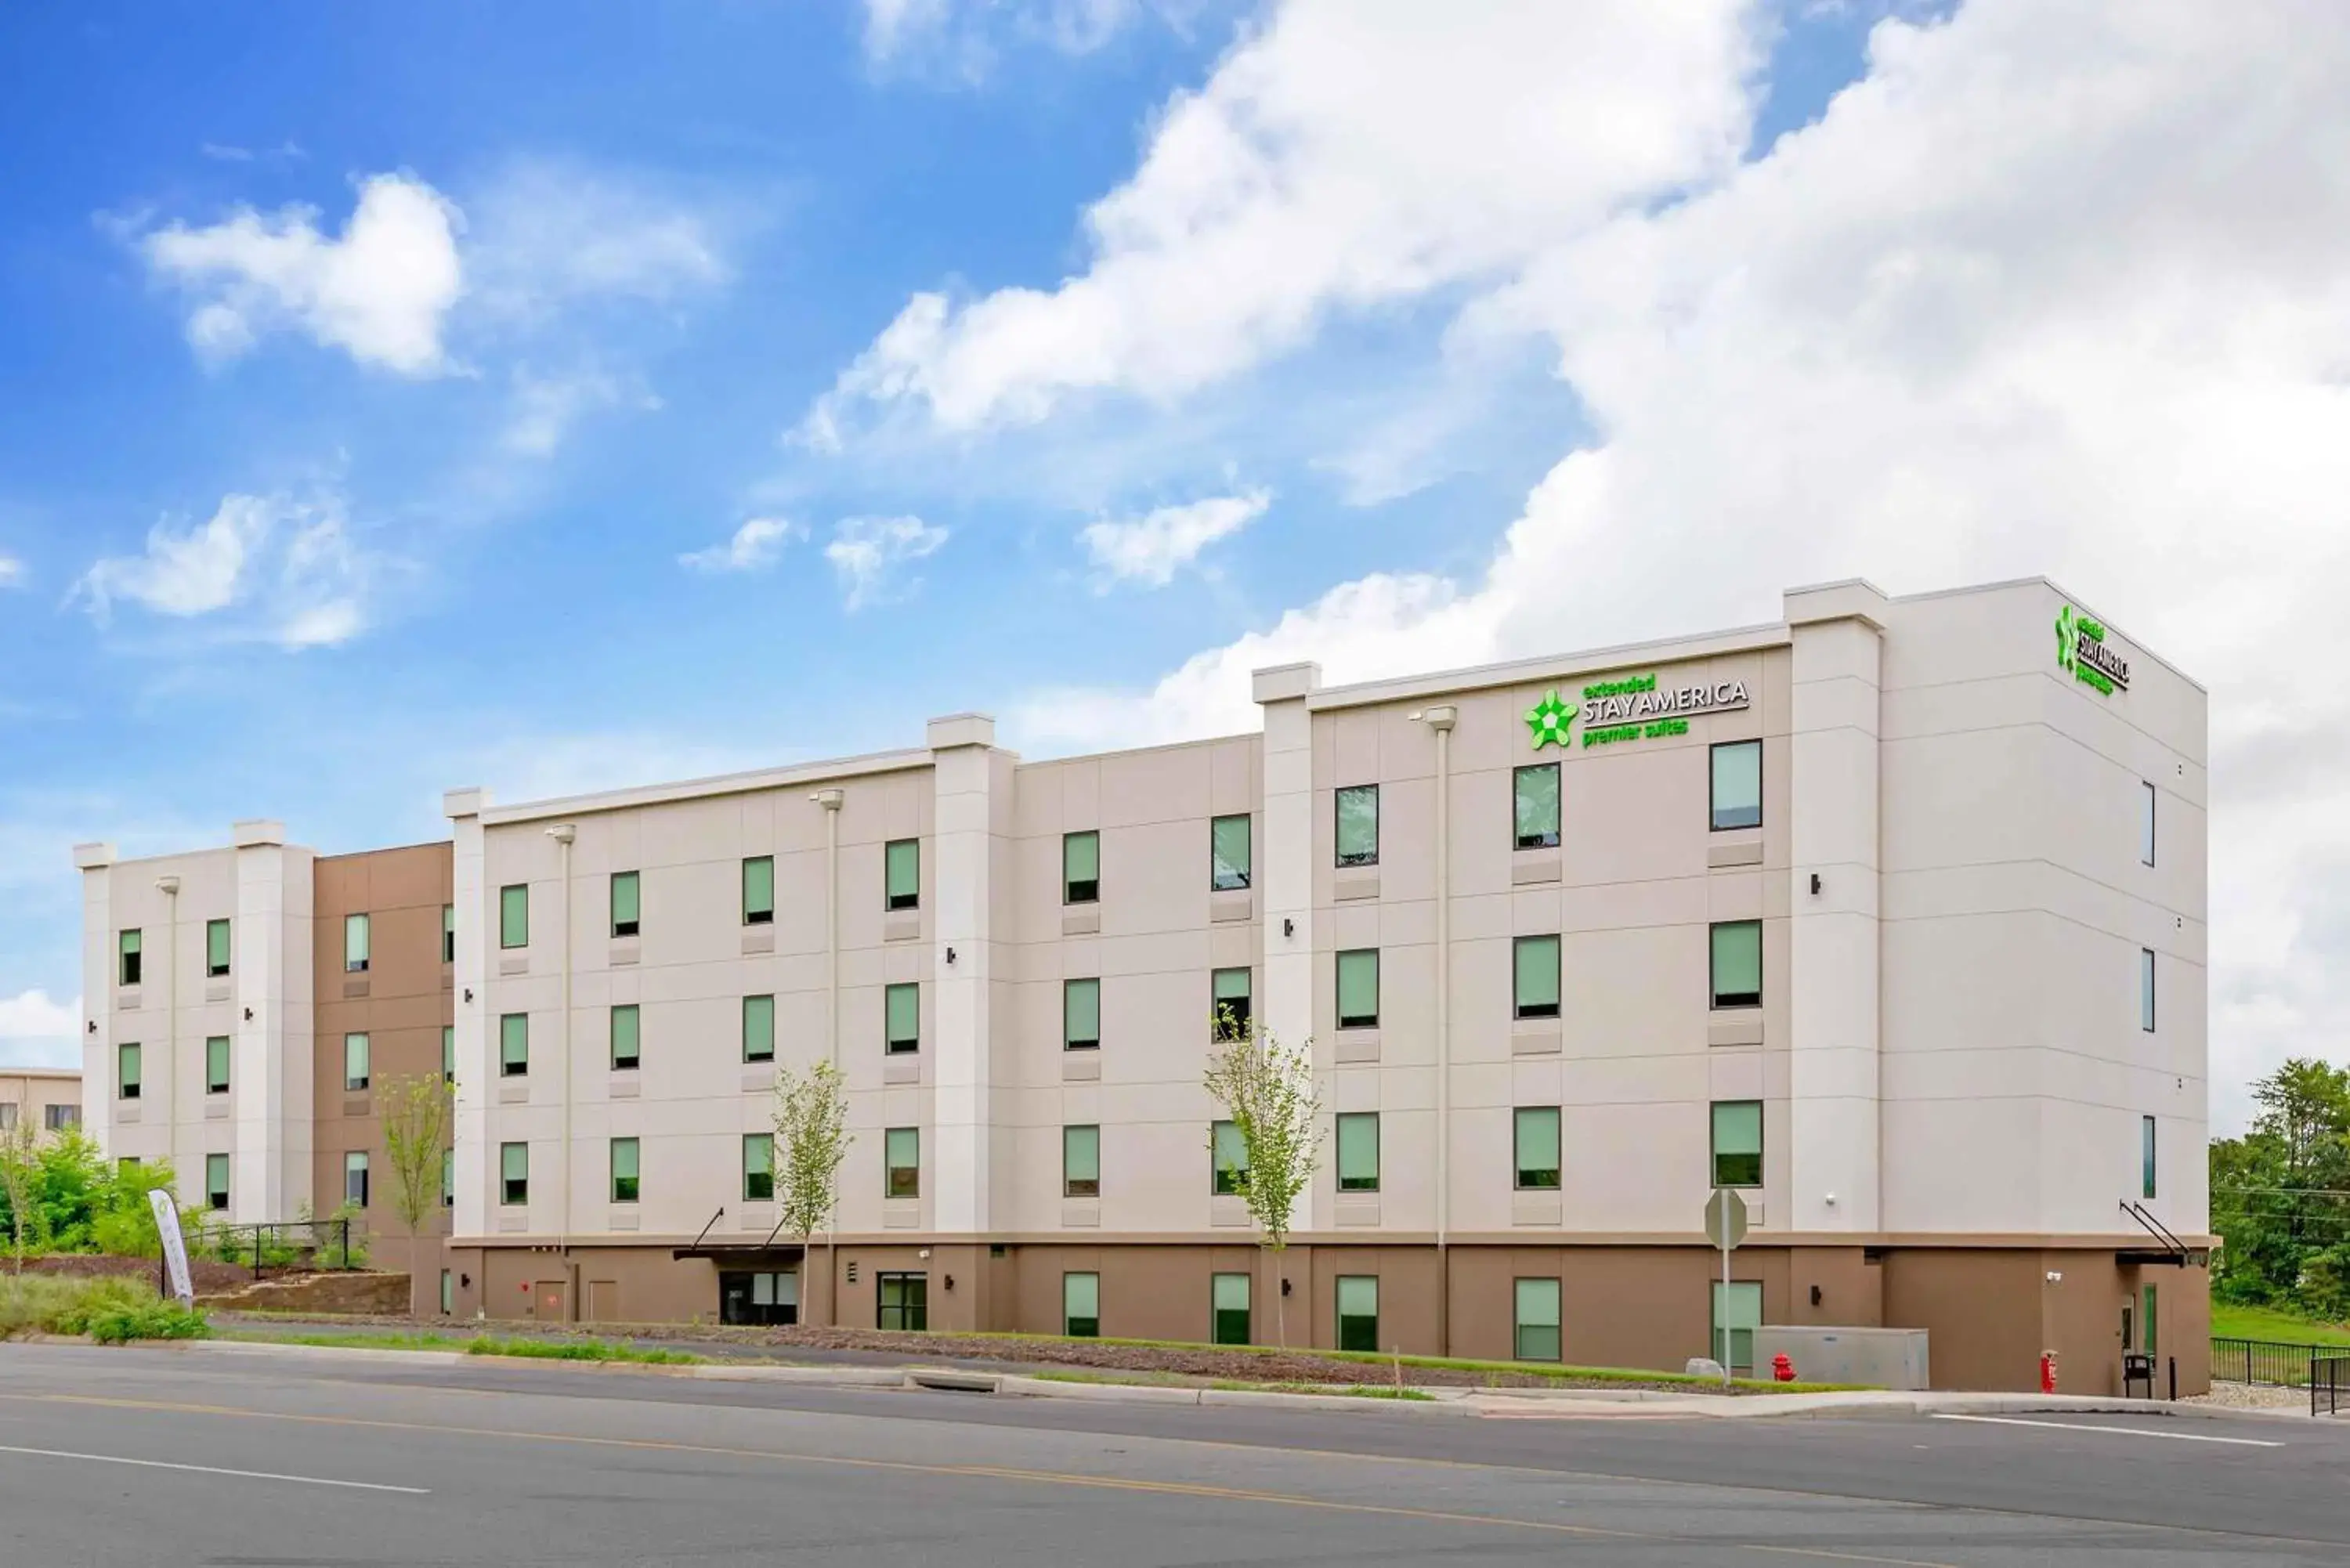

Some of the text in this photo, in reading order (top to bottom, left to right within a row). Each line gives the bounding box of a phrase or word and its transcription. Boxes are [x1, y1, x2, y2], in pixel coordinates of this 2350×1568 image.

[1582, 673, 1655, 699] extended
[1584, 680, 1749, 722] STAY AMERICA
[1582, 719, 1689, 749] premier suites
